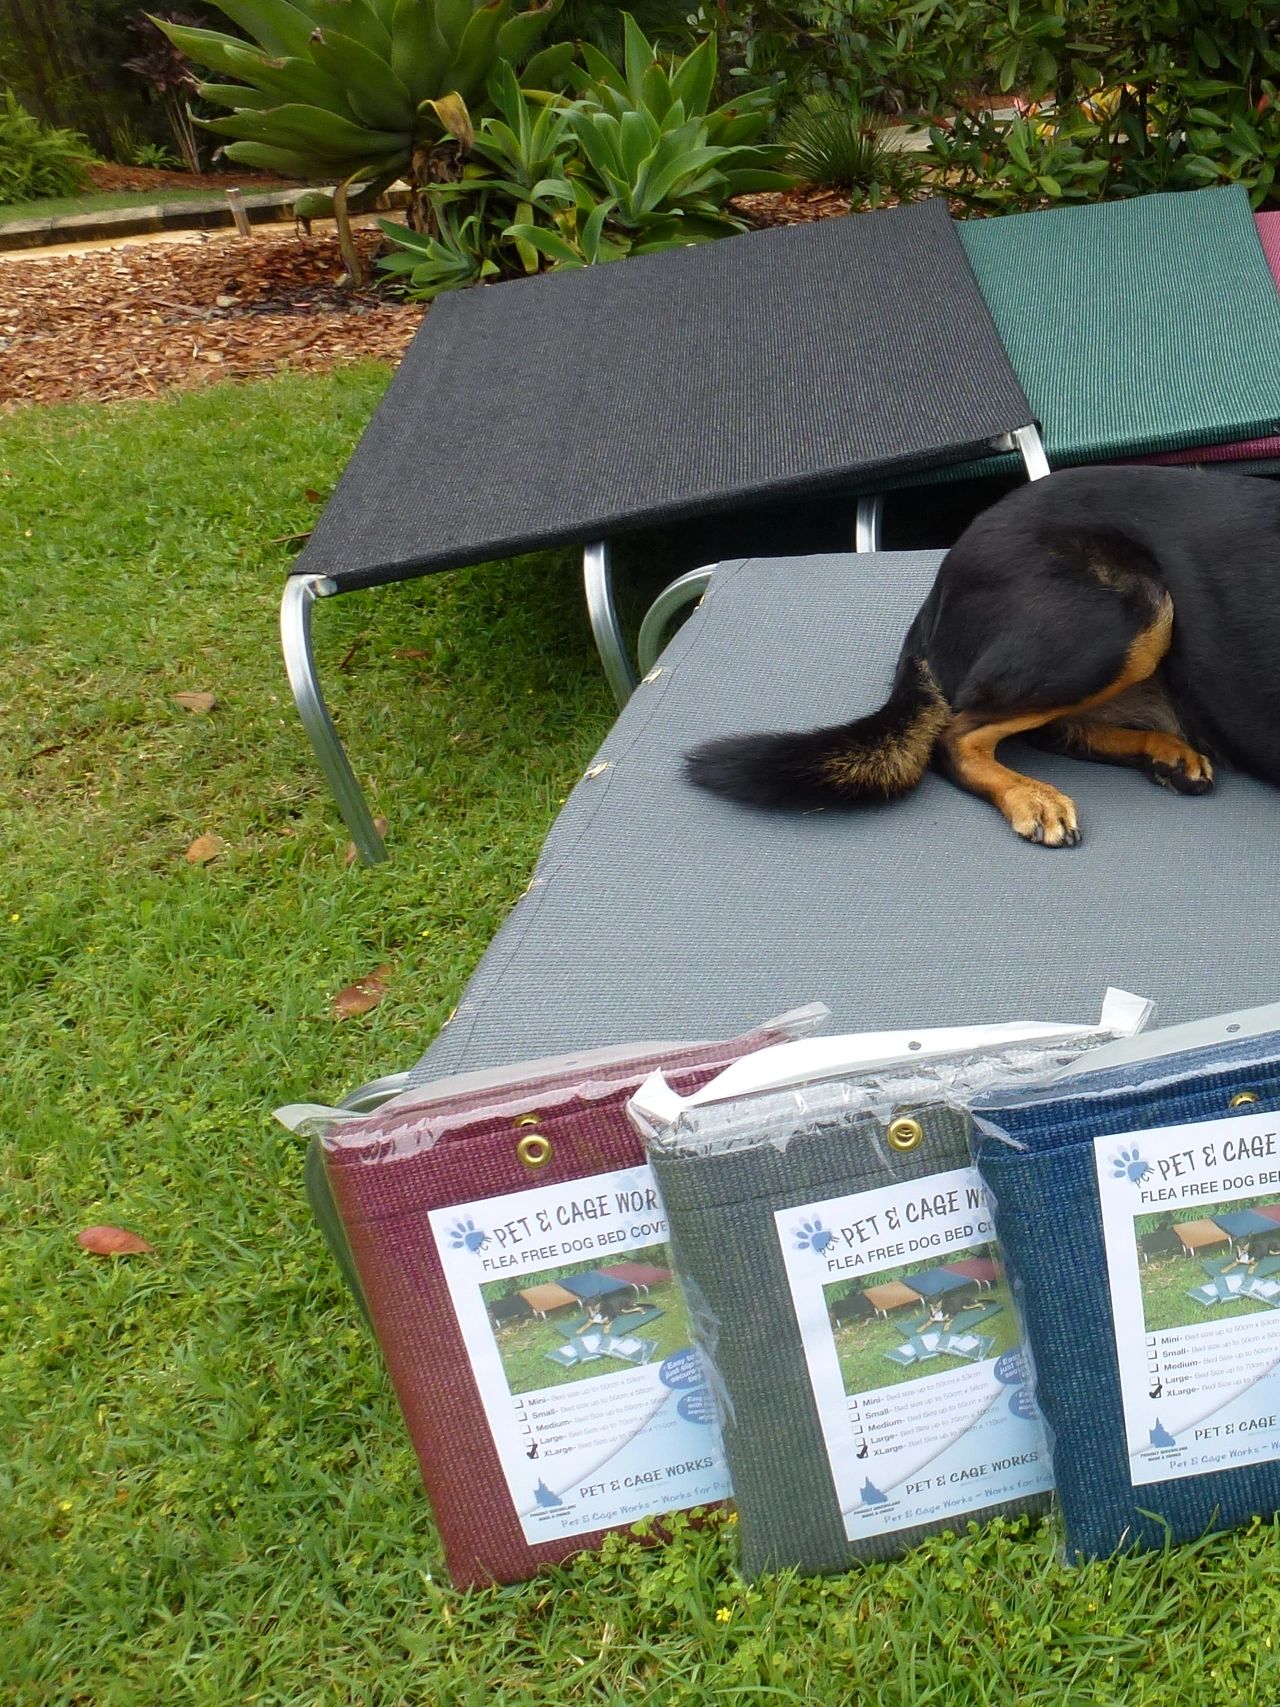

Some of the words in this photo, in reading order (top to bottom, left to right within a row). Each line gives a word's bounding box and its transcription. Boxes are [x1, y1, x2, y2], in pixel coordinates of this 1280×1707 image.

[1158, 1150, 1195, 1181] PET
[1202, 1144, 1217, 1167] &
[1223, 1133, 1276, 1162] CAGE
[1141, 1188, 1177, 1203] FLEA
[1181, 1181, 1218, 1197] FREE
[1223, 1175, 1254, 1191] DOG
[493, 1217, 531, 1248] PET
[536, 1209, 552, 1232] &
[556, 1195, 610, 1225] CAGE
[615, 1188, 658, 1214] WOR
[841, 1216, 879, 1248] PET
[885, 1207, 901, 1230] &
[906, 1190, 959, 1223] CAGE
[482, 1254, 518, 1271] FLEA
[521, 1245, 558, 1263] FREE
[562, 1237, 594, 1254] DOG
[597, 1230, 626, 1246] BED
[631, 1220, 667, 1238] COVE
[828, 1254, 864, 1272] FLEA
[868, 1243, 905, 1262] FREE
[909, 1234, 941, 1252] DOG
[944, 1225, 974, 1242] BED
[1195, 1426, 1220, 1441] PET
[1225, 1423, 1234, 1435] &
[1239, 1415, 1276, 1431] CAGE
[580, 1483, 605, 1498] PET
[624, 1469, 662, 1487] CAGE
[666, 1457, 713, 1477] WORKS
[906, 1480, 931, 1495] PET
[950, 1464, 987, 1483] CAGE
[992, 1451, 1038, 1471] WORKS
